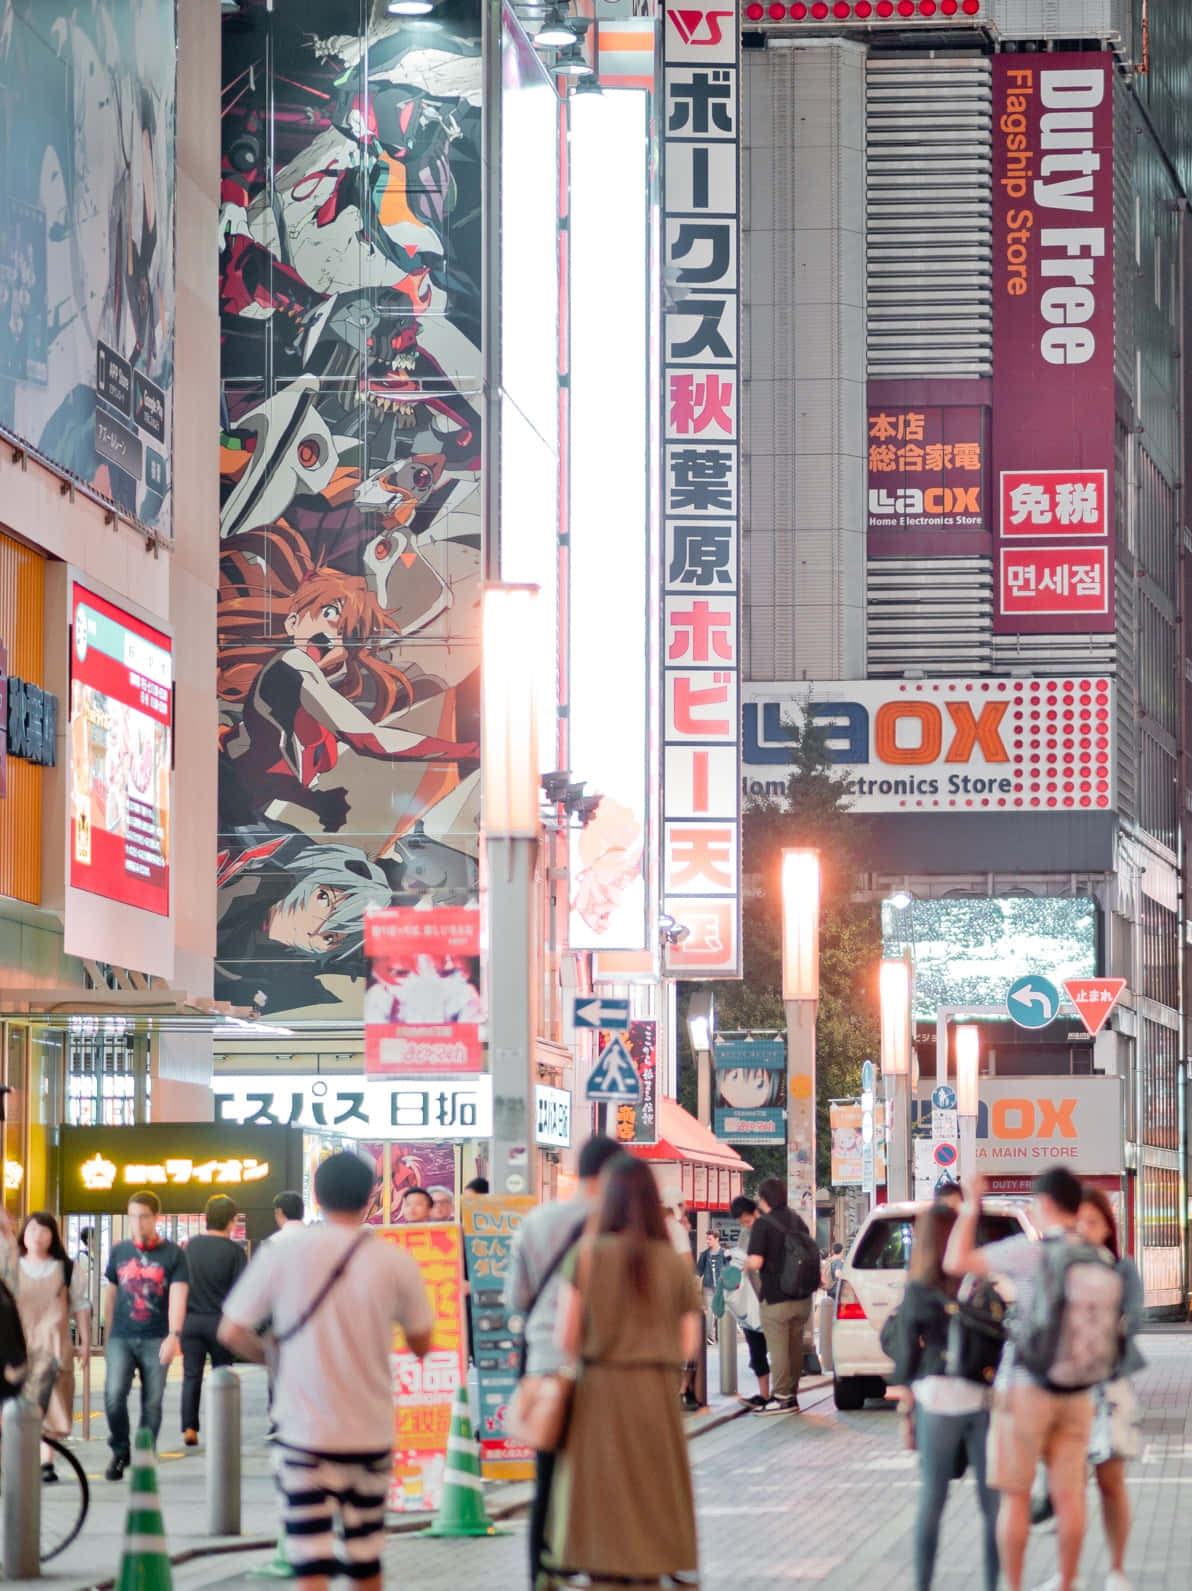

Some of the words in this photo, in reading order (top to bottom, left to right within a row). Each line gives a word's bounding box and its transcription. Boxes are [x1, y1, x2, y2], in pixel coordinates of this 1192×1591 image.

[1000, 69, 1033, 198] Flagship
[1033, 69, 1105, 212] Duty
[1006, 210, 1033, 296] Store
[1039, 228, 1105, 364] Free
[868, 412, 925, 441] 本店
[868, 443, 981, 472] 総合家電
[1009, 482, 1099, 525] 免税
[869, 516, 897, 526] Home
[898, 515, 954, 526] Electronics
[955, 514, 983, 525] Store
[1007, 563, 1101, 597] 면세점
[948, 774, 1012, 796] Store
[1074, 988, 1114, 1003] 止まれ
[992, 1147, 1028, 1158] MAIN
[1032, 1146, 1079, 1158] STORE
[992, 1180, 1017, 1190] DUTY
